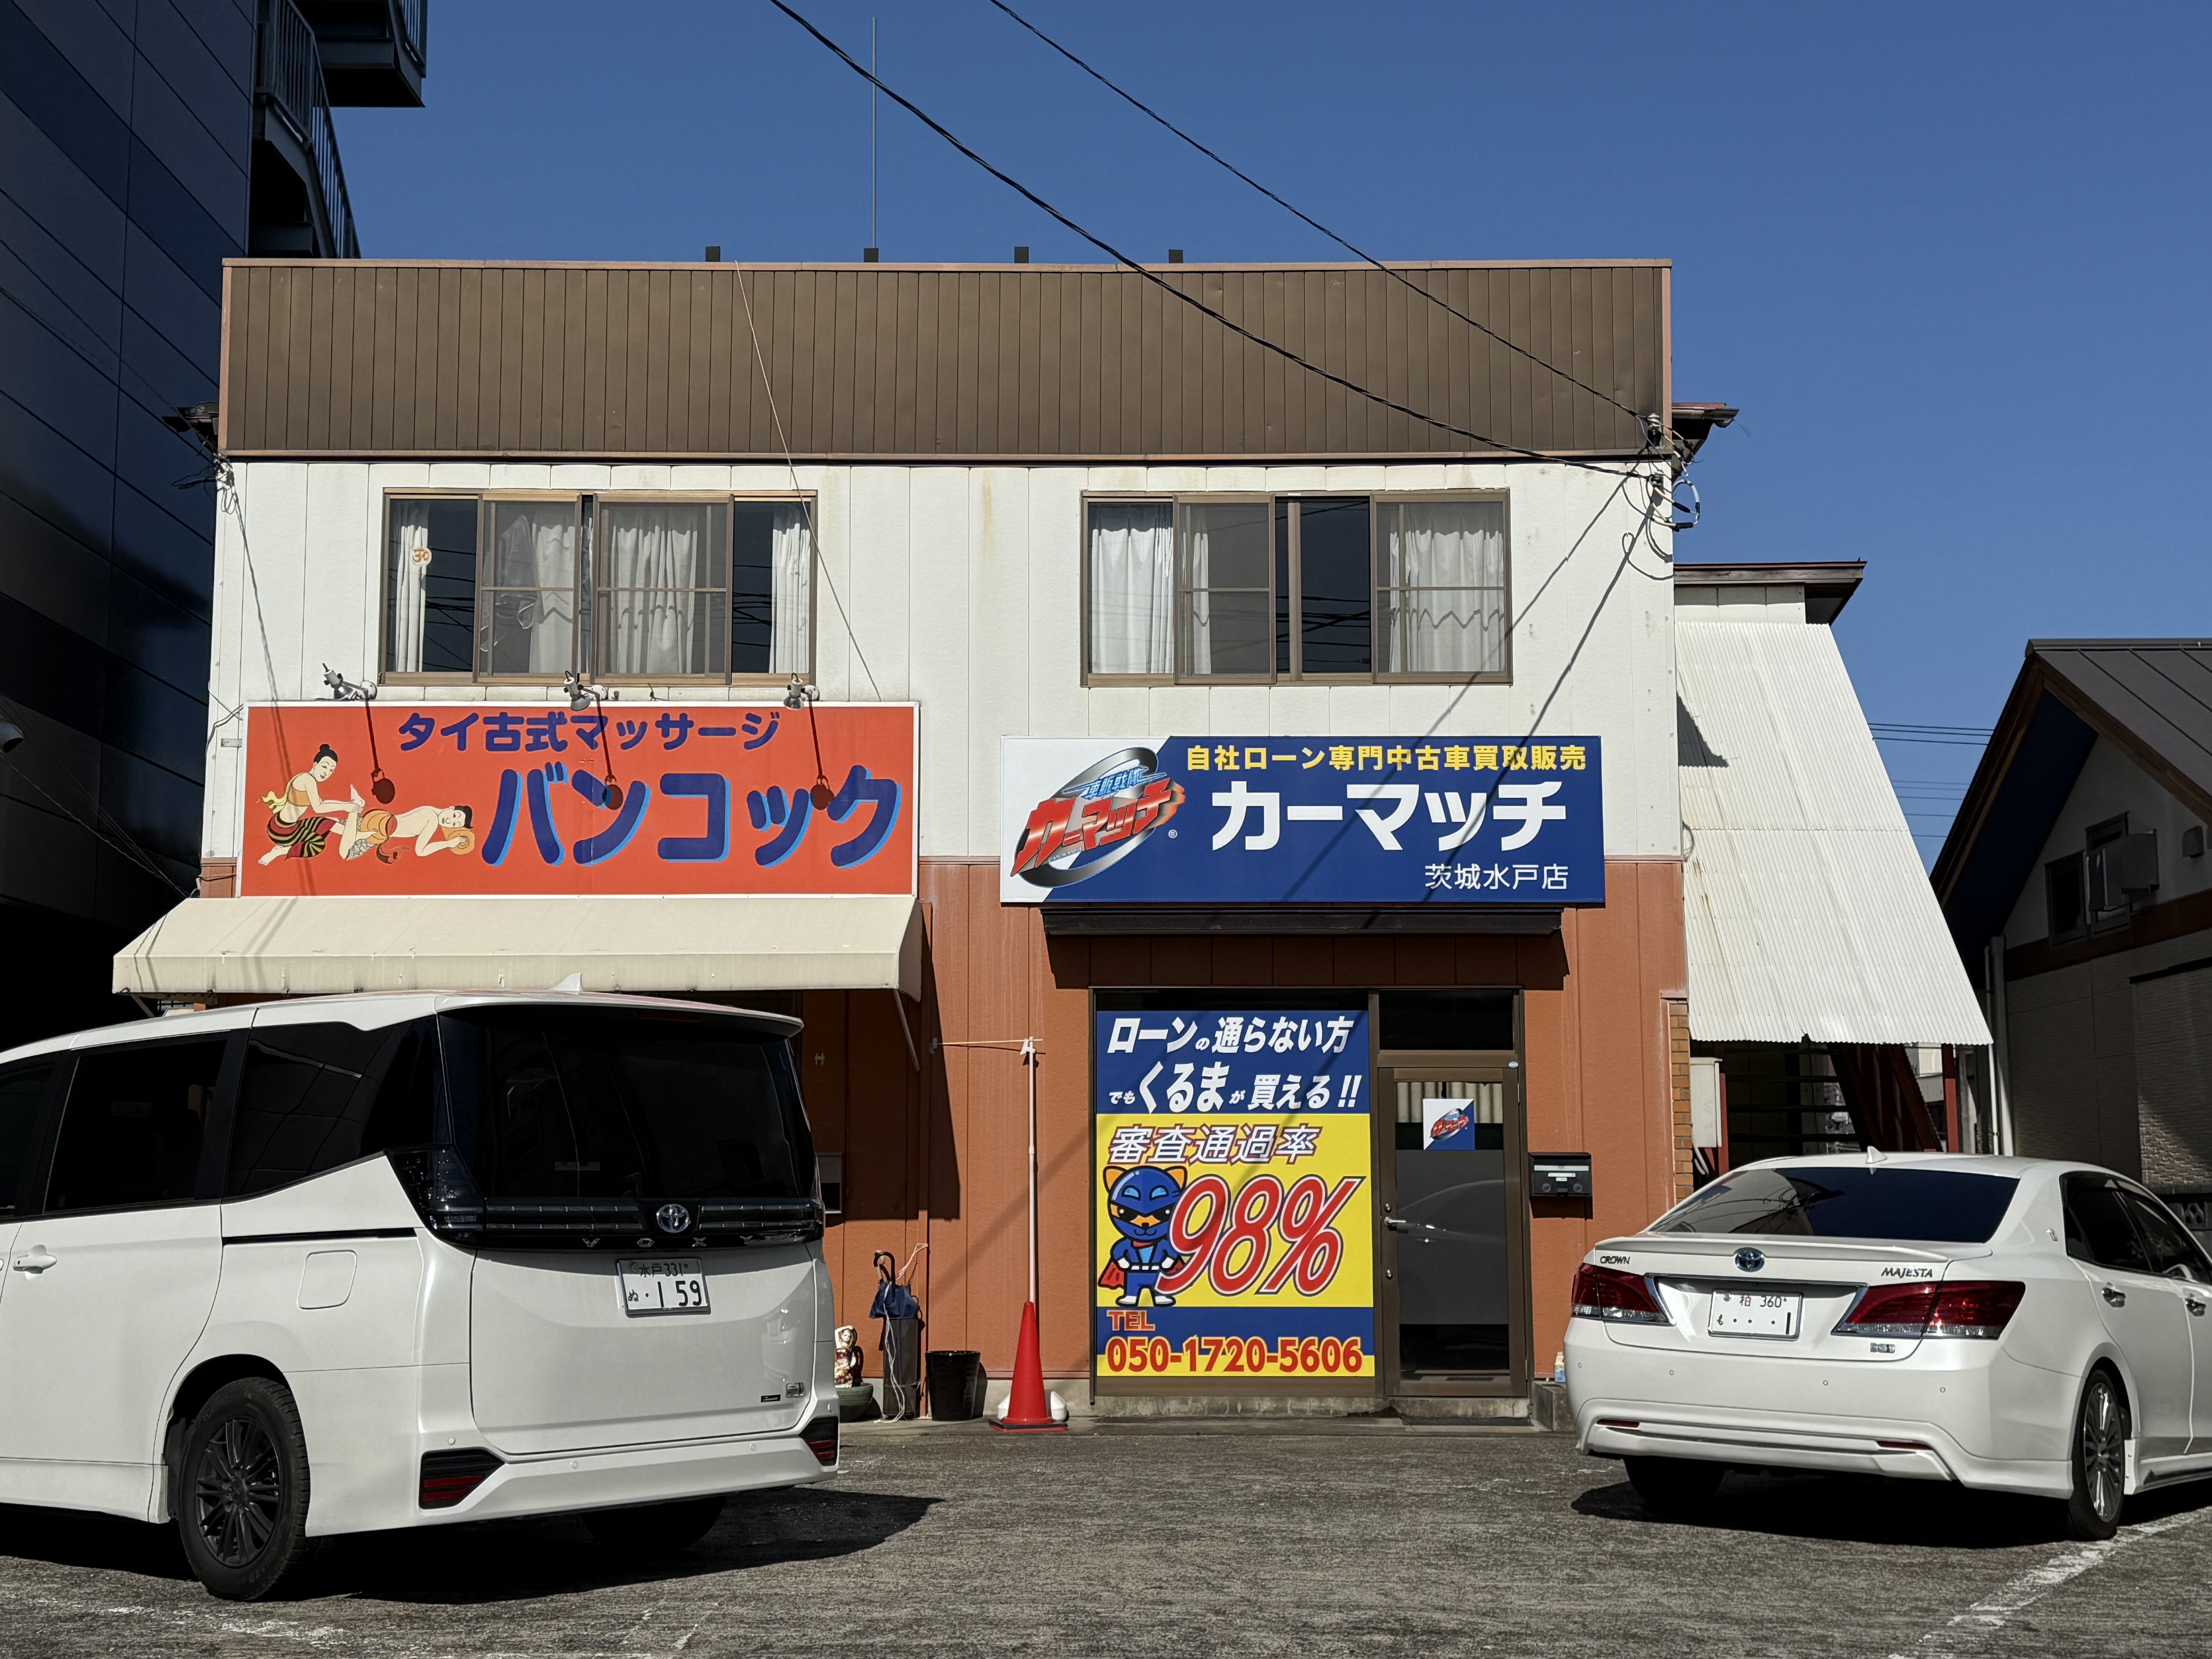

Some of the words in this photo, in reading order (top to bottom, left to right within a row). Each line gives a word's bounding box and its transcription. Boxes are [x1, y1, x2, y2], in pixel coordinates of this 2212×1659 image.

[399, 711, 780, 754] タイ古式マッサージ
[1187, 744, 1587, 771] 自社ローン専門中古車買取販売
[481, 761, 901, 869] バンコック
[1212, 780, 1567, 852] カーマッチ
[1424, 863, 1569, 890] 茨城水戸店
[1107, 1016, 1355, 1053] ローンの通らない方
[1107, 1123, 1321, 1166] 審査通過率
[1154, 1173, 1366, 1296] 98%
[1600, 1255, 1630, 1264] CROWN
[1881, 1267, 1933, 1278] MAJESTA
[1106, 1310, 1156, 1331] TEL
[1104, 1335, 1363, 1373] 050-1720-5606
